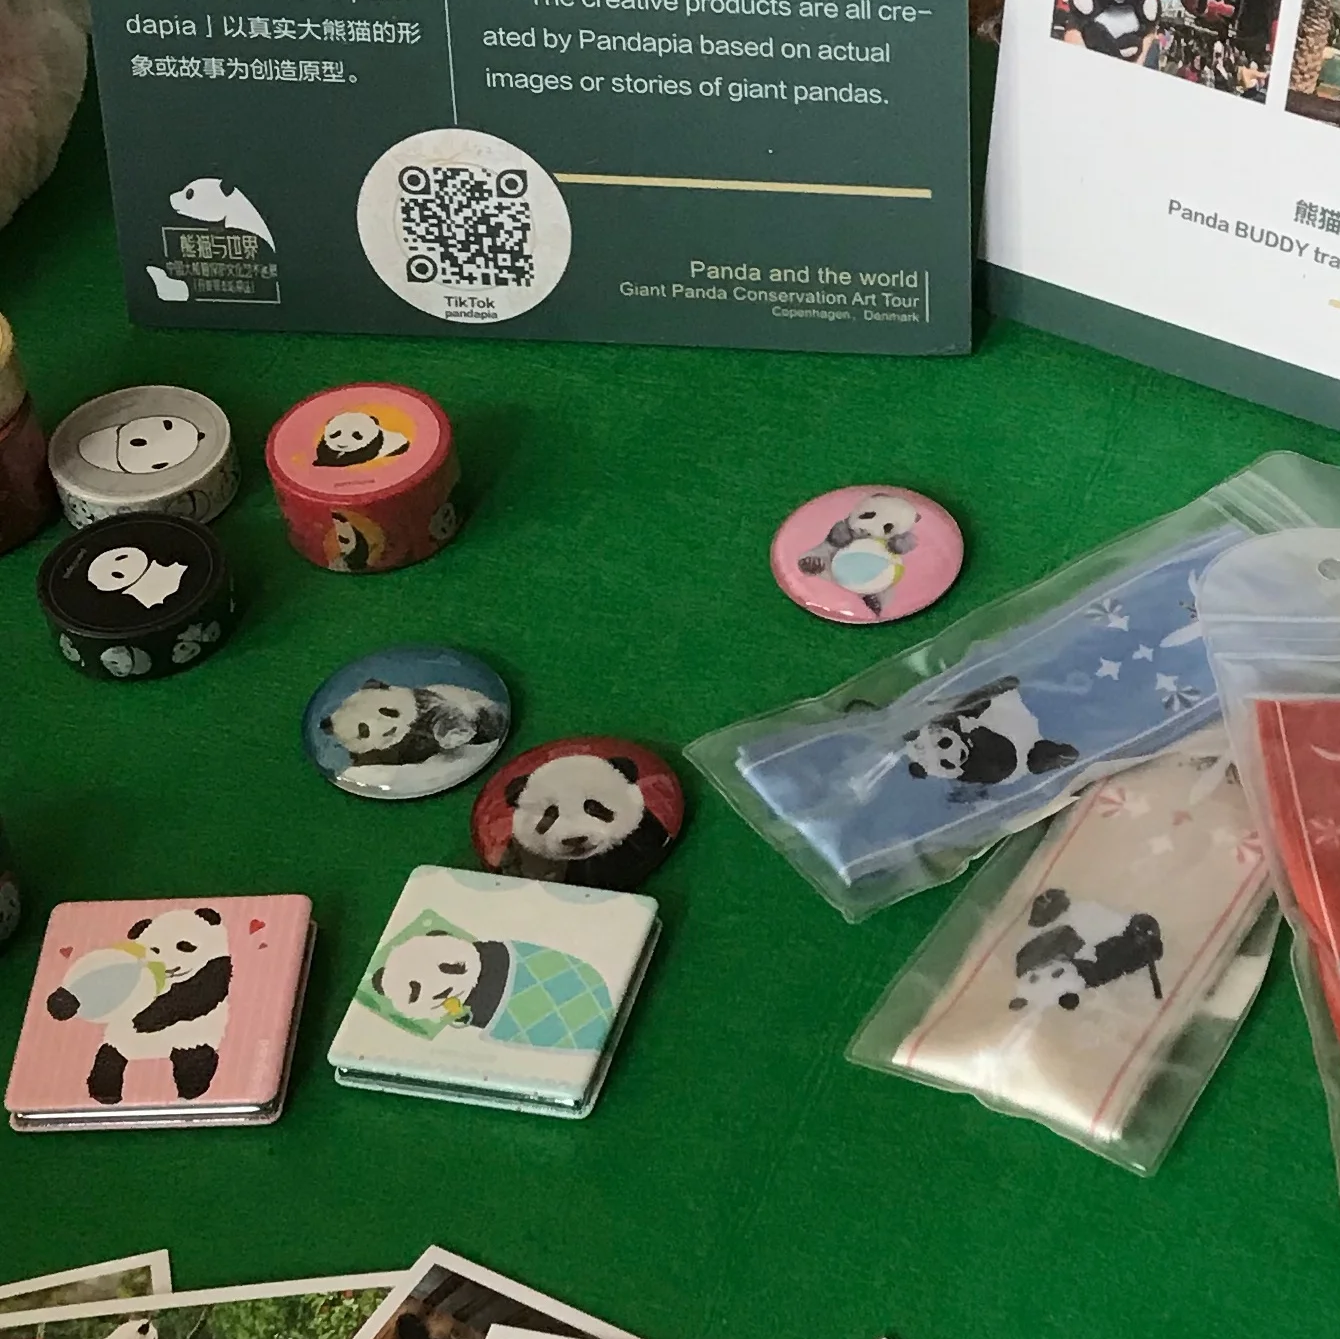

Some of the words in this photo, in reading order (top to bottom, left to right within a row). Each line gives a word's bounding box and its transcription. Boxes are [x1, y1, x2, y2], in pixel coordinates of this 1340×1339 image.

[482, 26, 536, 48] ated
[542, 27, 573, 54] by
[578, 28, 694, 58] Pandapia
[699, 33, 774, 59] based
[780, 42, 812, 59] on
[817, 41, 891, 63] actual
[485, 67, 574, 94] images
[579, 75, 605, 92] or
[611, 73, 693, 96] stories
[698, 76, 724, 97] of
[727, 77, 788, 103] giant
[793, 82, 889, 106] pandas.
[1168, 198, 1230, 235] Panda
[1234, 220, 1310, 259] BUDDY
[690, 260, 762, 282] Panda
[768, 265, 811, 284] and
[818, 267, 853, 286] the
[860, 269, 919, 289] world
[443, 296, 496, 310] TikTok
[619, 281, 668, 299] Giant
[671, 283, 729, 301] Panda
[732, 286, 848, 307] Conservation
[851, 289, 877, 307] Art
[881, 292, 920, 309] Tour
[444, 308, 499, 322] pandapia
[864, 308, 920, 323] Denmark
